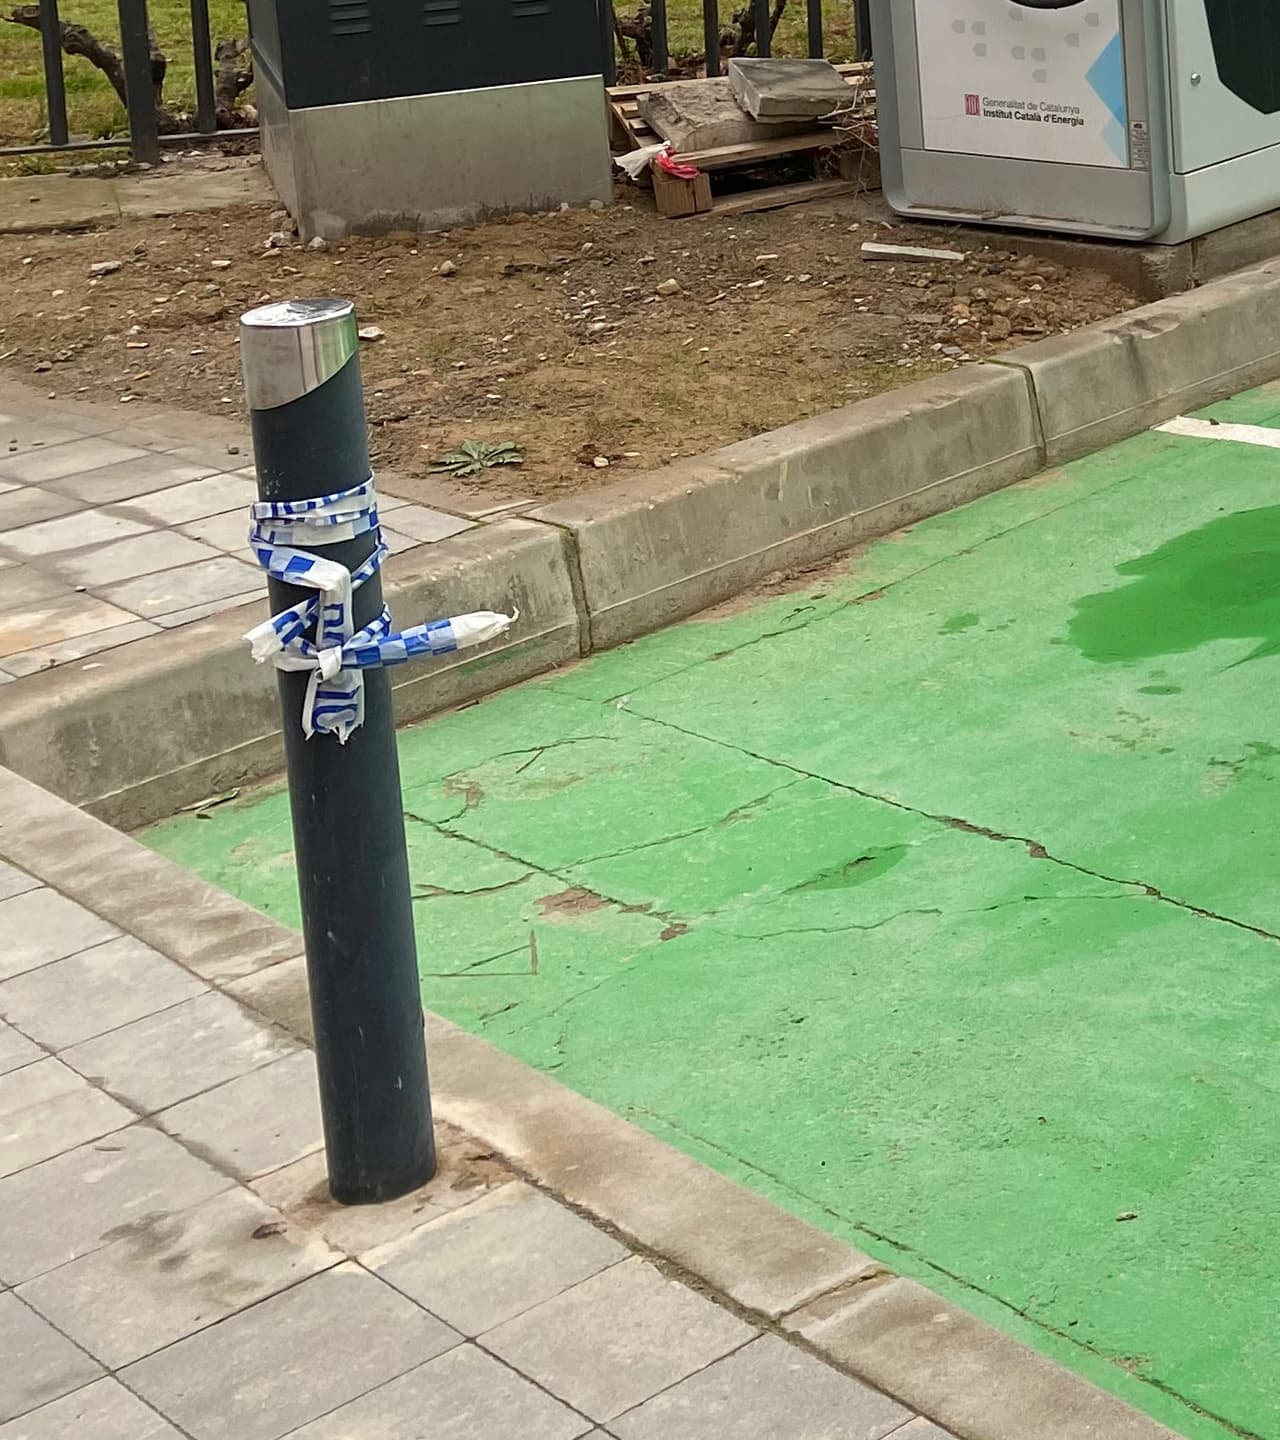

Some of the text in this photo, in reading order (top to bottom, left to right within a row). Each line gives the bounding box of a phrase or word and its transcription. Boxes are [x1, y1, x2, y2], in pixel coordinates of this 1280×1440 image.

[982, 97, 1080, 115] Generalitat de Catalunya
[983, 108, 1084, 127] Institut Català d'Energia
